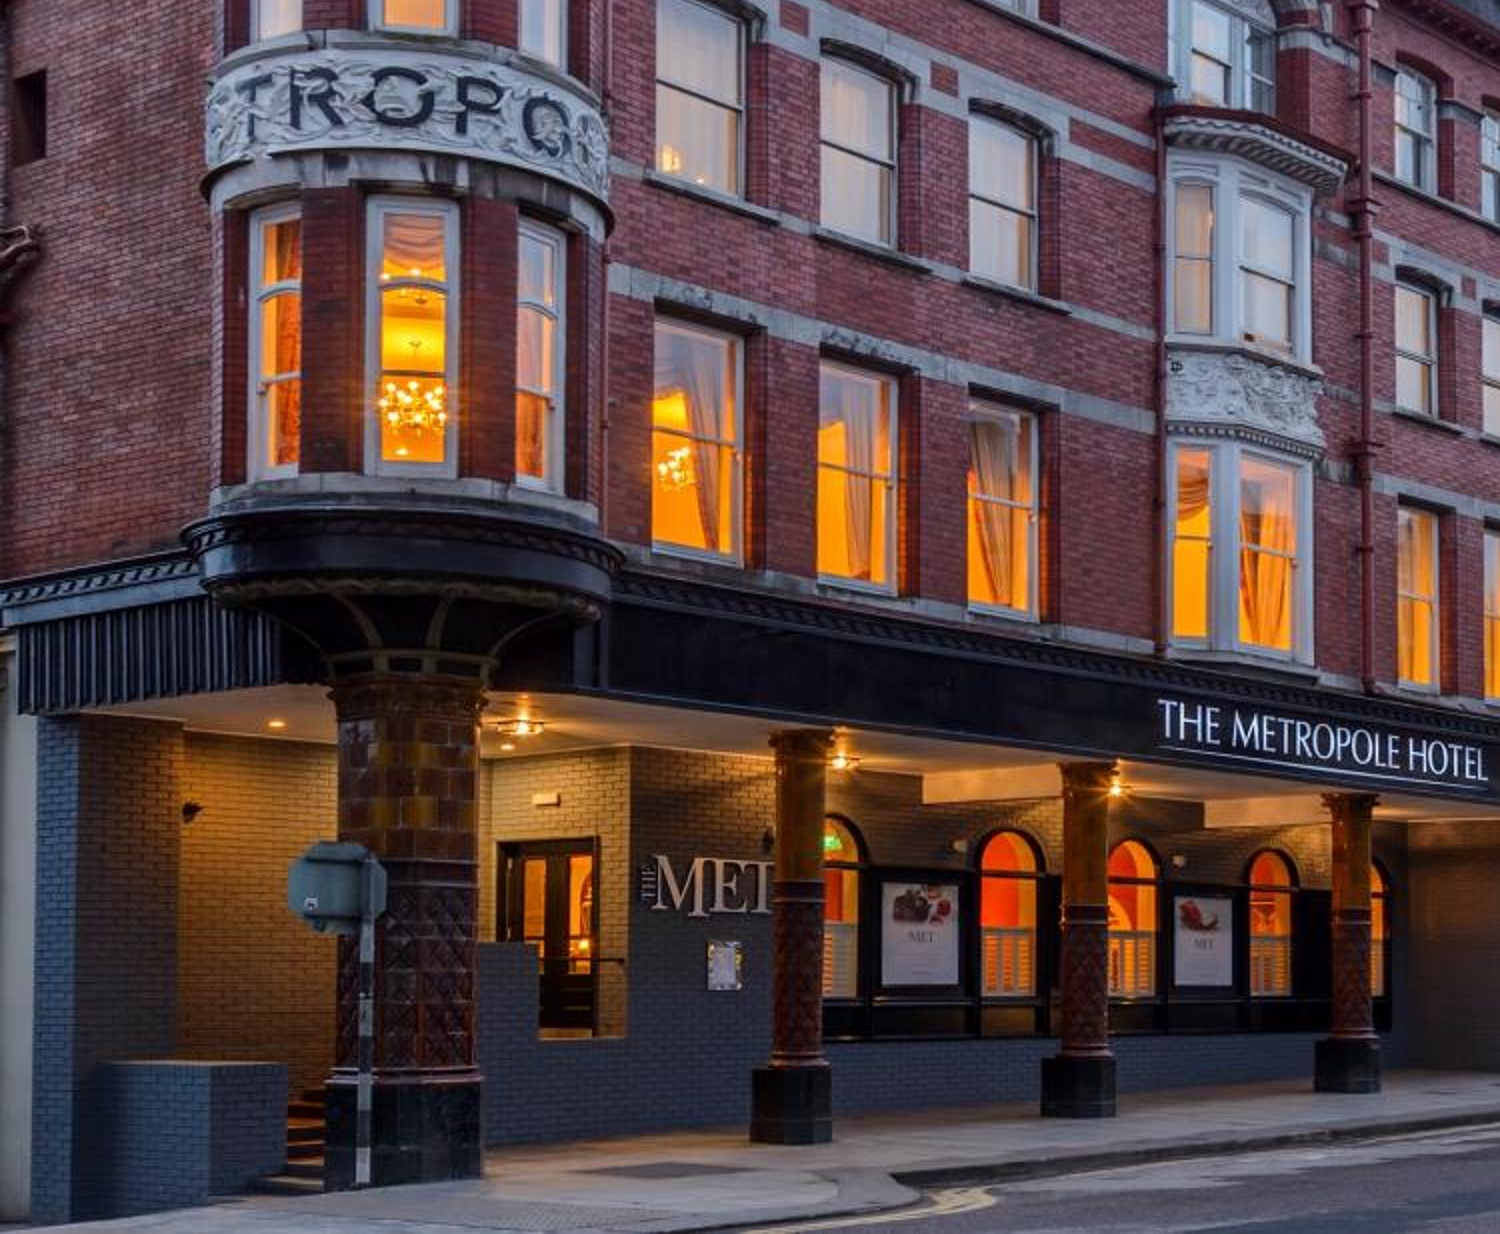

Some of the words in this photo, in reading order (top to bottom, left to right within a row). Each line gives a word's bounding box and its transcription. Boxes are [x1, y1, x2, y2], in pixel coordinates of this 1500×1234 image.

[1157, 698, 1222, 745] THE
[1231, 709, 1401, 769] METROPOLE
[1408, 737, 1489, 781] HOTEL
[651, 854, 776, 917] MET
